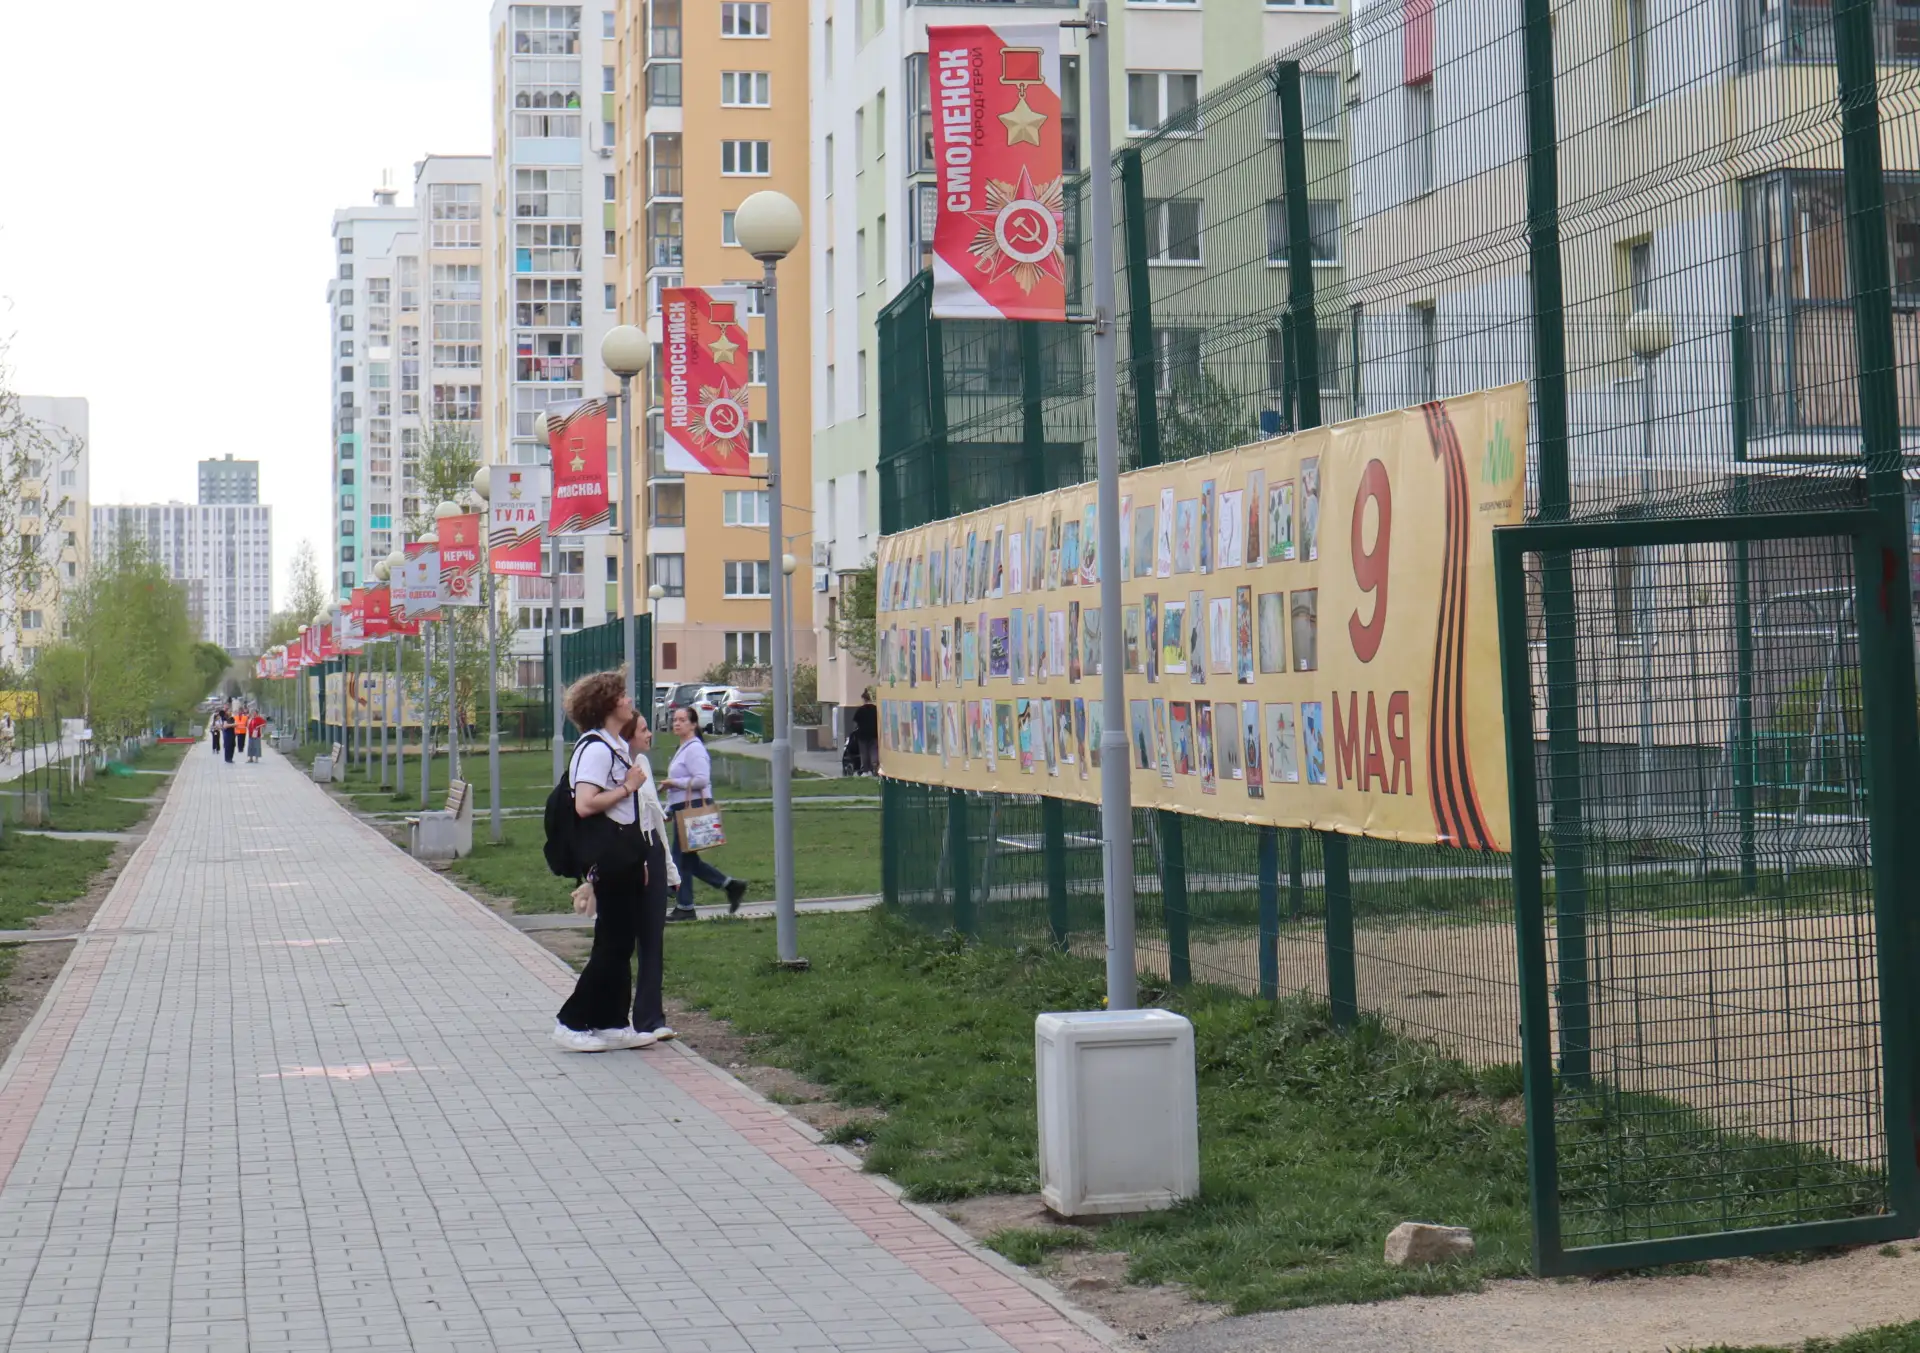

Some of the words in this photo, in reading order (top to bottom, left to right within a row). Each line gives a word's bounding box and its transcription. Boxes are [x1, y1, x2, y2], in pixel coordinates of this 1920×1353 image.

[939, 47, 972, 212] СМОЛЕНСК
[972, 47, 985, 147] ГОРОД-ГЕРОЙ
[668, 302, 688, 427] НОВОРОССИЙСК
[495, 508, 536, 522] ТУЛА
[557, 482, 602, 498] МОСКВА
[408, 590, 437, 599] ОДЕССА
[443, 550, 475, 562] КЕРЧЬ
[1348, 458, 1392, 664] 9
[1332, 690, 1413, 796] МАЯ
